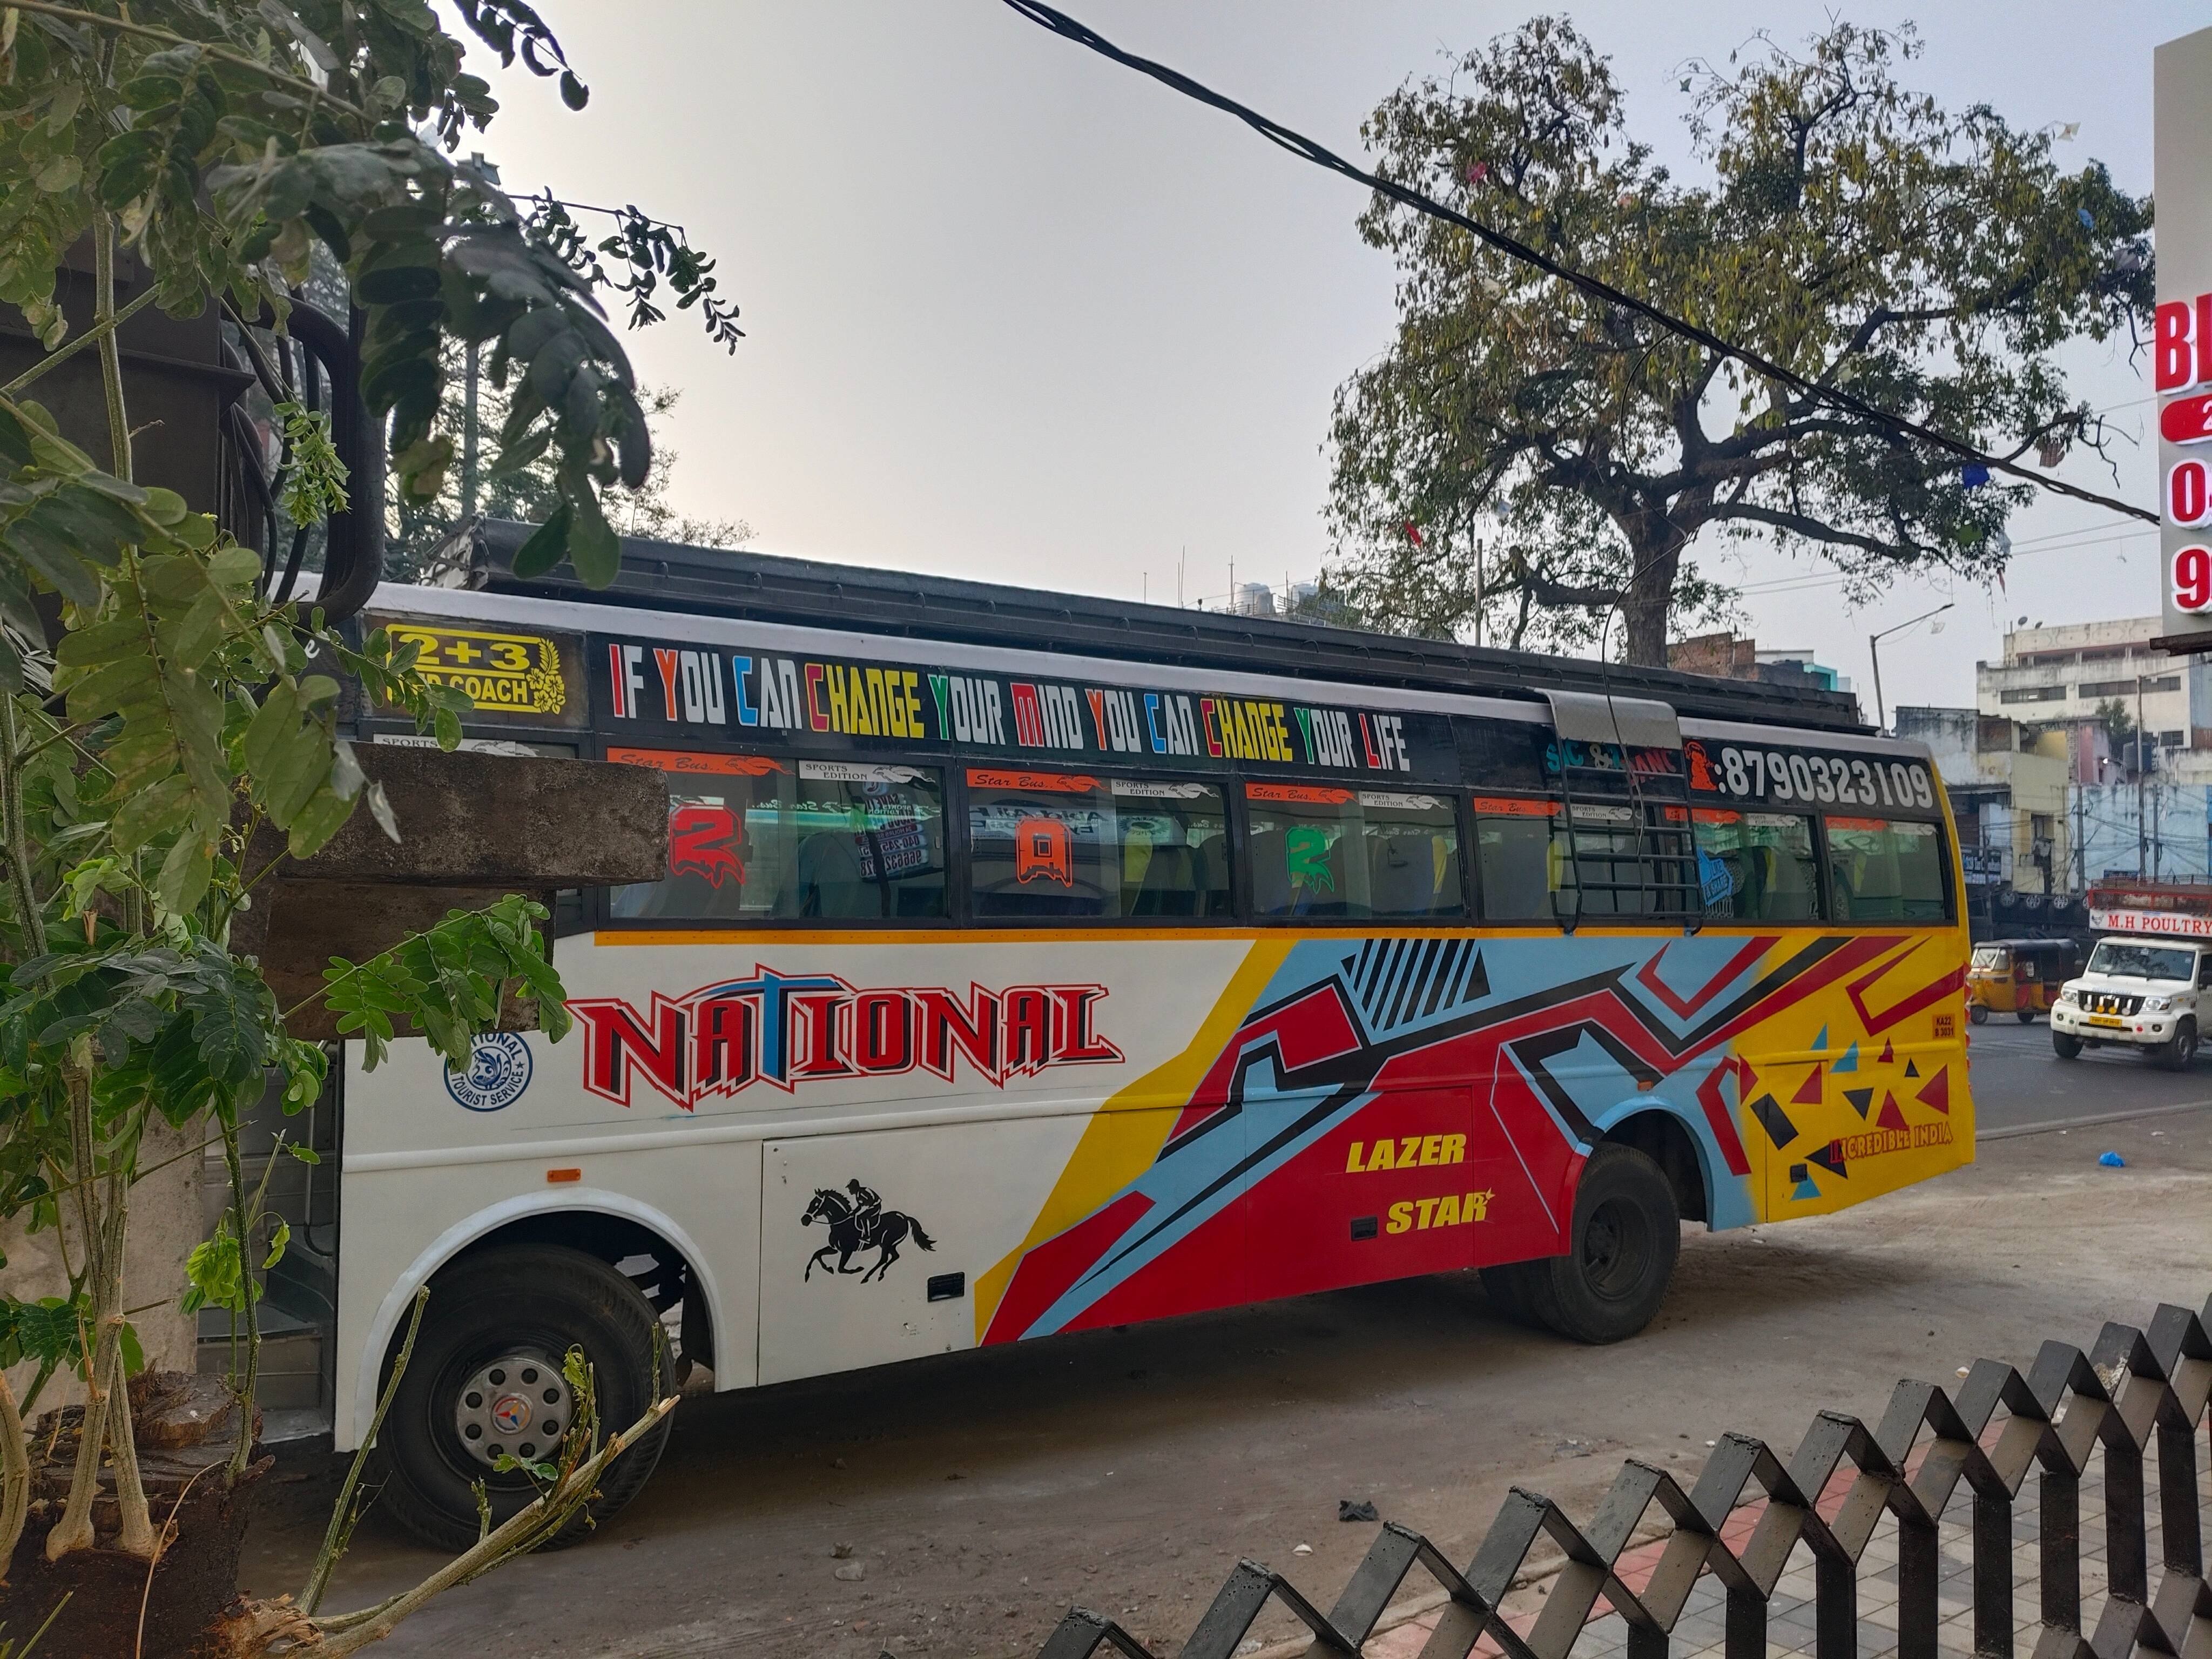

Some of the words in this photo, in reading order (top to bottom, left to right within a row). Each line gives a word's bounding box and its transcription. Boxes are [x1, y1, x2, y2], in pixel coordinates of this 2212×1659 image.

[399, 633, 530, 671] 2+3
[450, 675, 528, 703] COACH
[609, 643, 644, 719] IF
[652, 648, 726, 725] YOU
[732, 655, 803, 730] CAN
[804, 662, 925, 739] CHANGE
[927, 673, 1007, 746] YOUR
[1009, 682, 1084, 750] MIND
[1084, 688, 1142, 753] YOU
[1143, 692, 1200, 756] CAN
[1199, 697, 1293, 762] CHANGE
[1293, 706, 1357, 768] YOUR
[1358, 712, 1411, 772] LIFE
[382, 738, 438, 748] SPORTS
[620, 754, 664, 768] Star
[805, 764, 848, 772] SPORTS
[823, 772, 868, 780] EDITION
[974, 774, 1011, 786] Star
[1252, 787, 1282, 799] Star
[1479, 801, 1503, 812] Star
[2108, 914, 2135, 929] M.H
[2142, 917, 2212, 934] POULTRY
[562, 963, 1126, 1112] NATIONAL
[451, 1074, 487, 1106] TOURIST
[490, 1070, 524, 1105] SERVICE
[1345, 1133, 1467, 1173] LAZER
[1829, 1125, 1911, 1164] INCREDIBLE
[1914, 1121, 1954, 1148] INDIA
[1385, 1191, 1492, 1235] STAR
